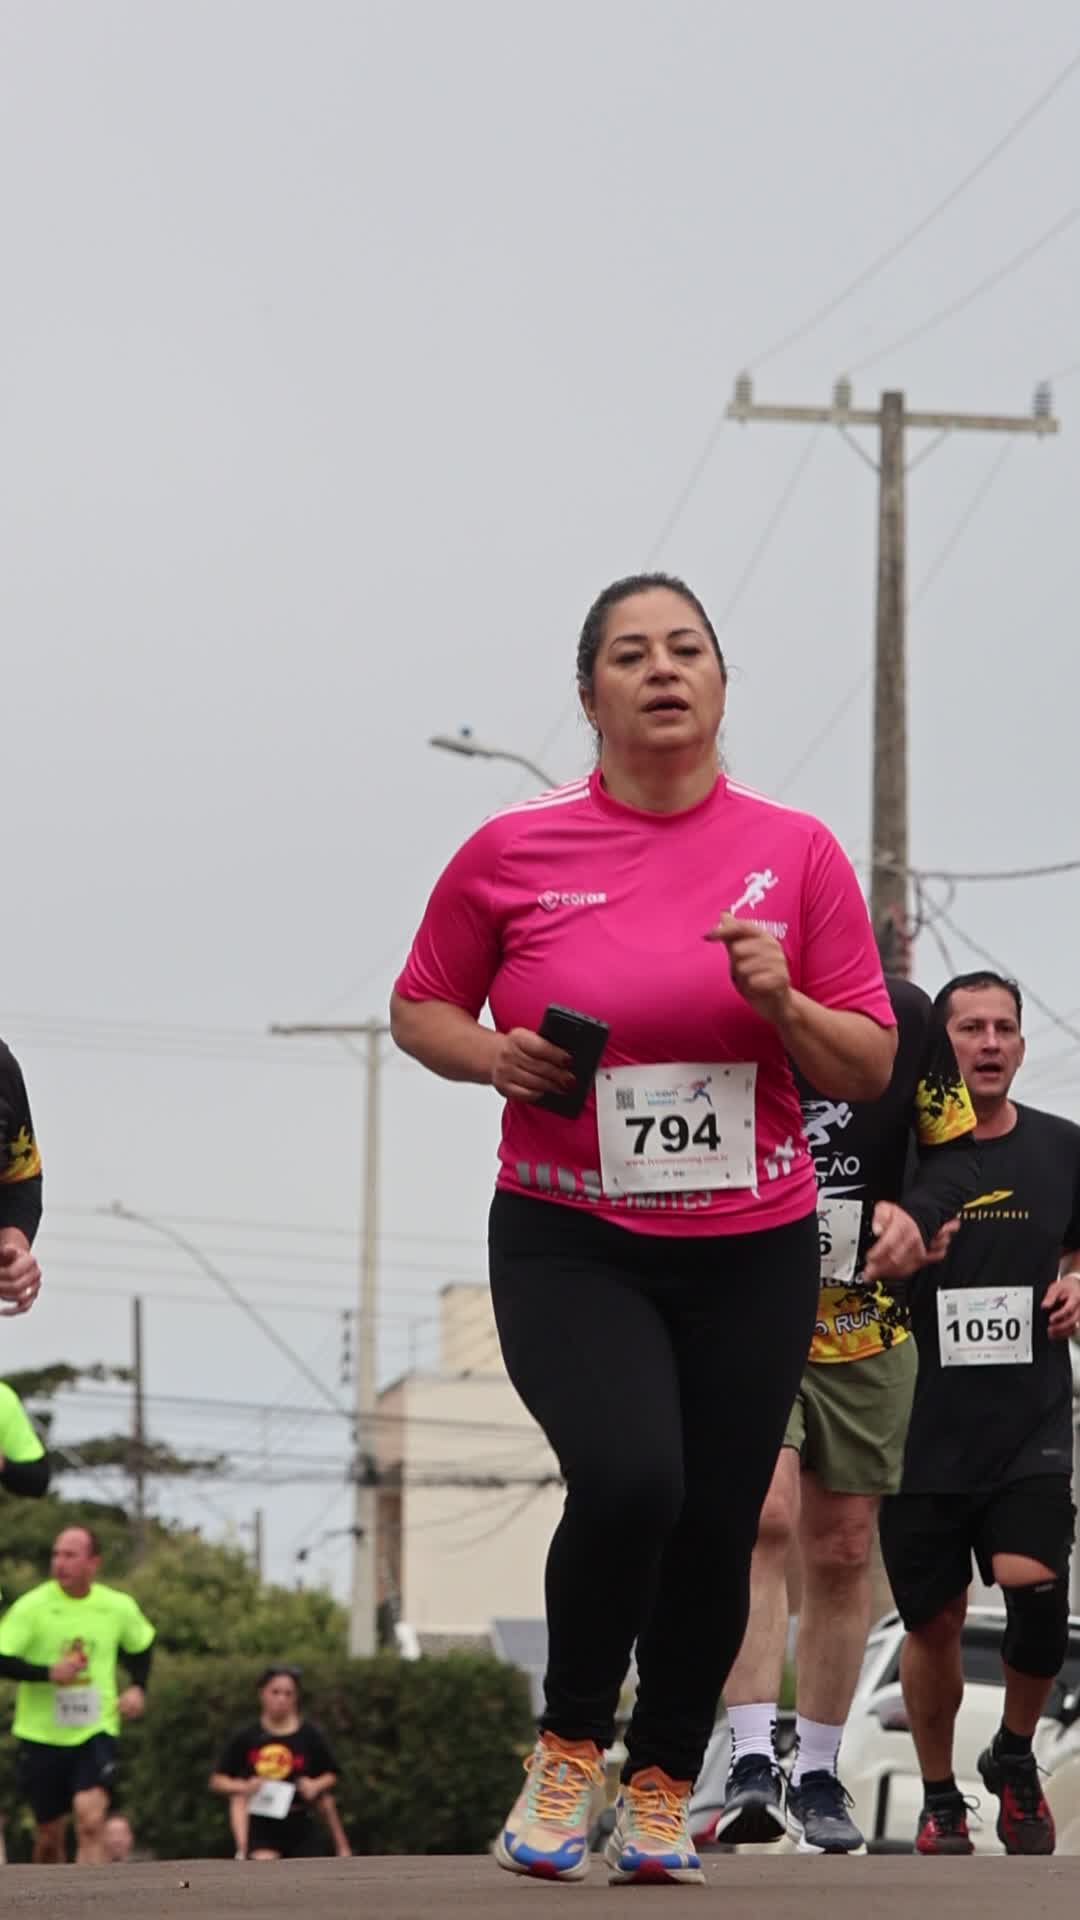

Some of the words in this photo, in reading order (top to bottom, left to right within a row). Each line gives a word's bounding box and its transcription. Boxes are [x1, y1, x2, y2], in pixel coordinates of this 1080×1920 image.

[625, 1113, 721, 1155] 794
[836, 1307, 880, 1334] RUN
[946, 1318, 1021, 1342] 1050
